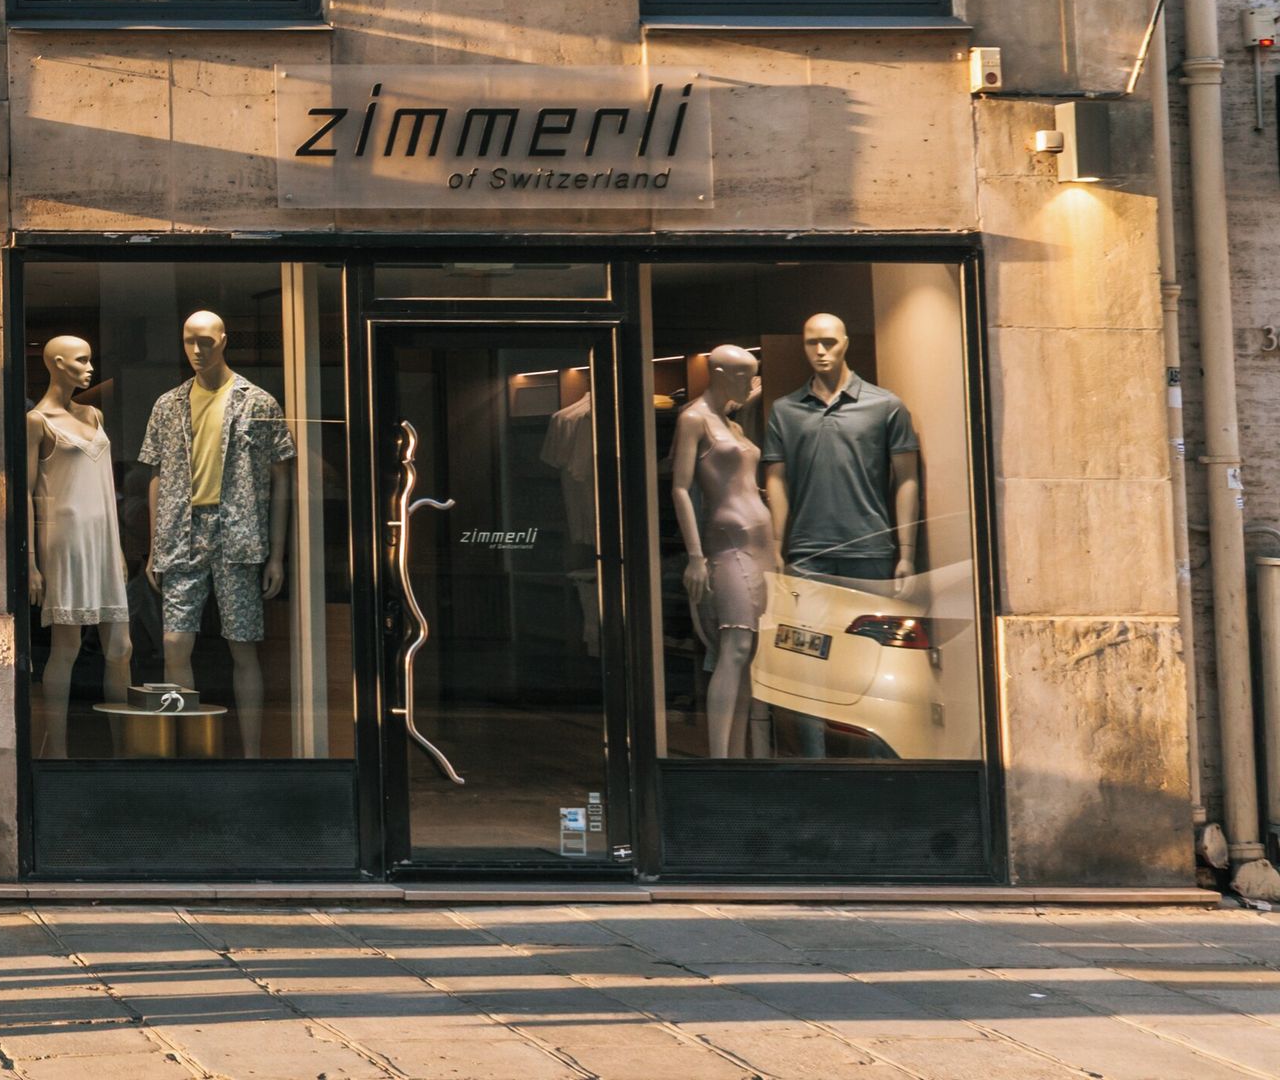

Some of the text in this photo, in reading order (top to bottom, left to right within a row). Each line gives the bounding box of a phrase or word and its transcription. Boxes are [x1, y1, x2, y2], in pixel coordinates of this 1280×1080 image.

[295, 83, 693, 157] zimmerli
[447, 167, 671, 190] of Switzerland
[1261, 325, 1280, 352] 3
[460, 527, 538, 543] zimmerli
